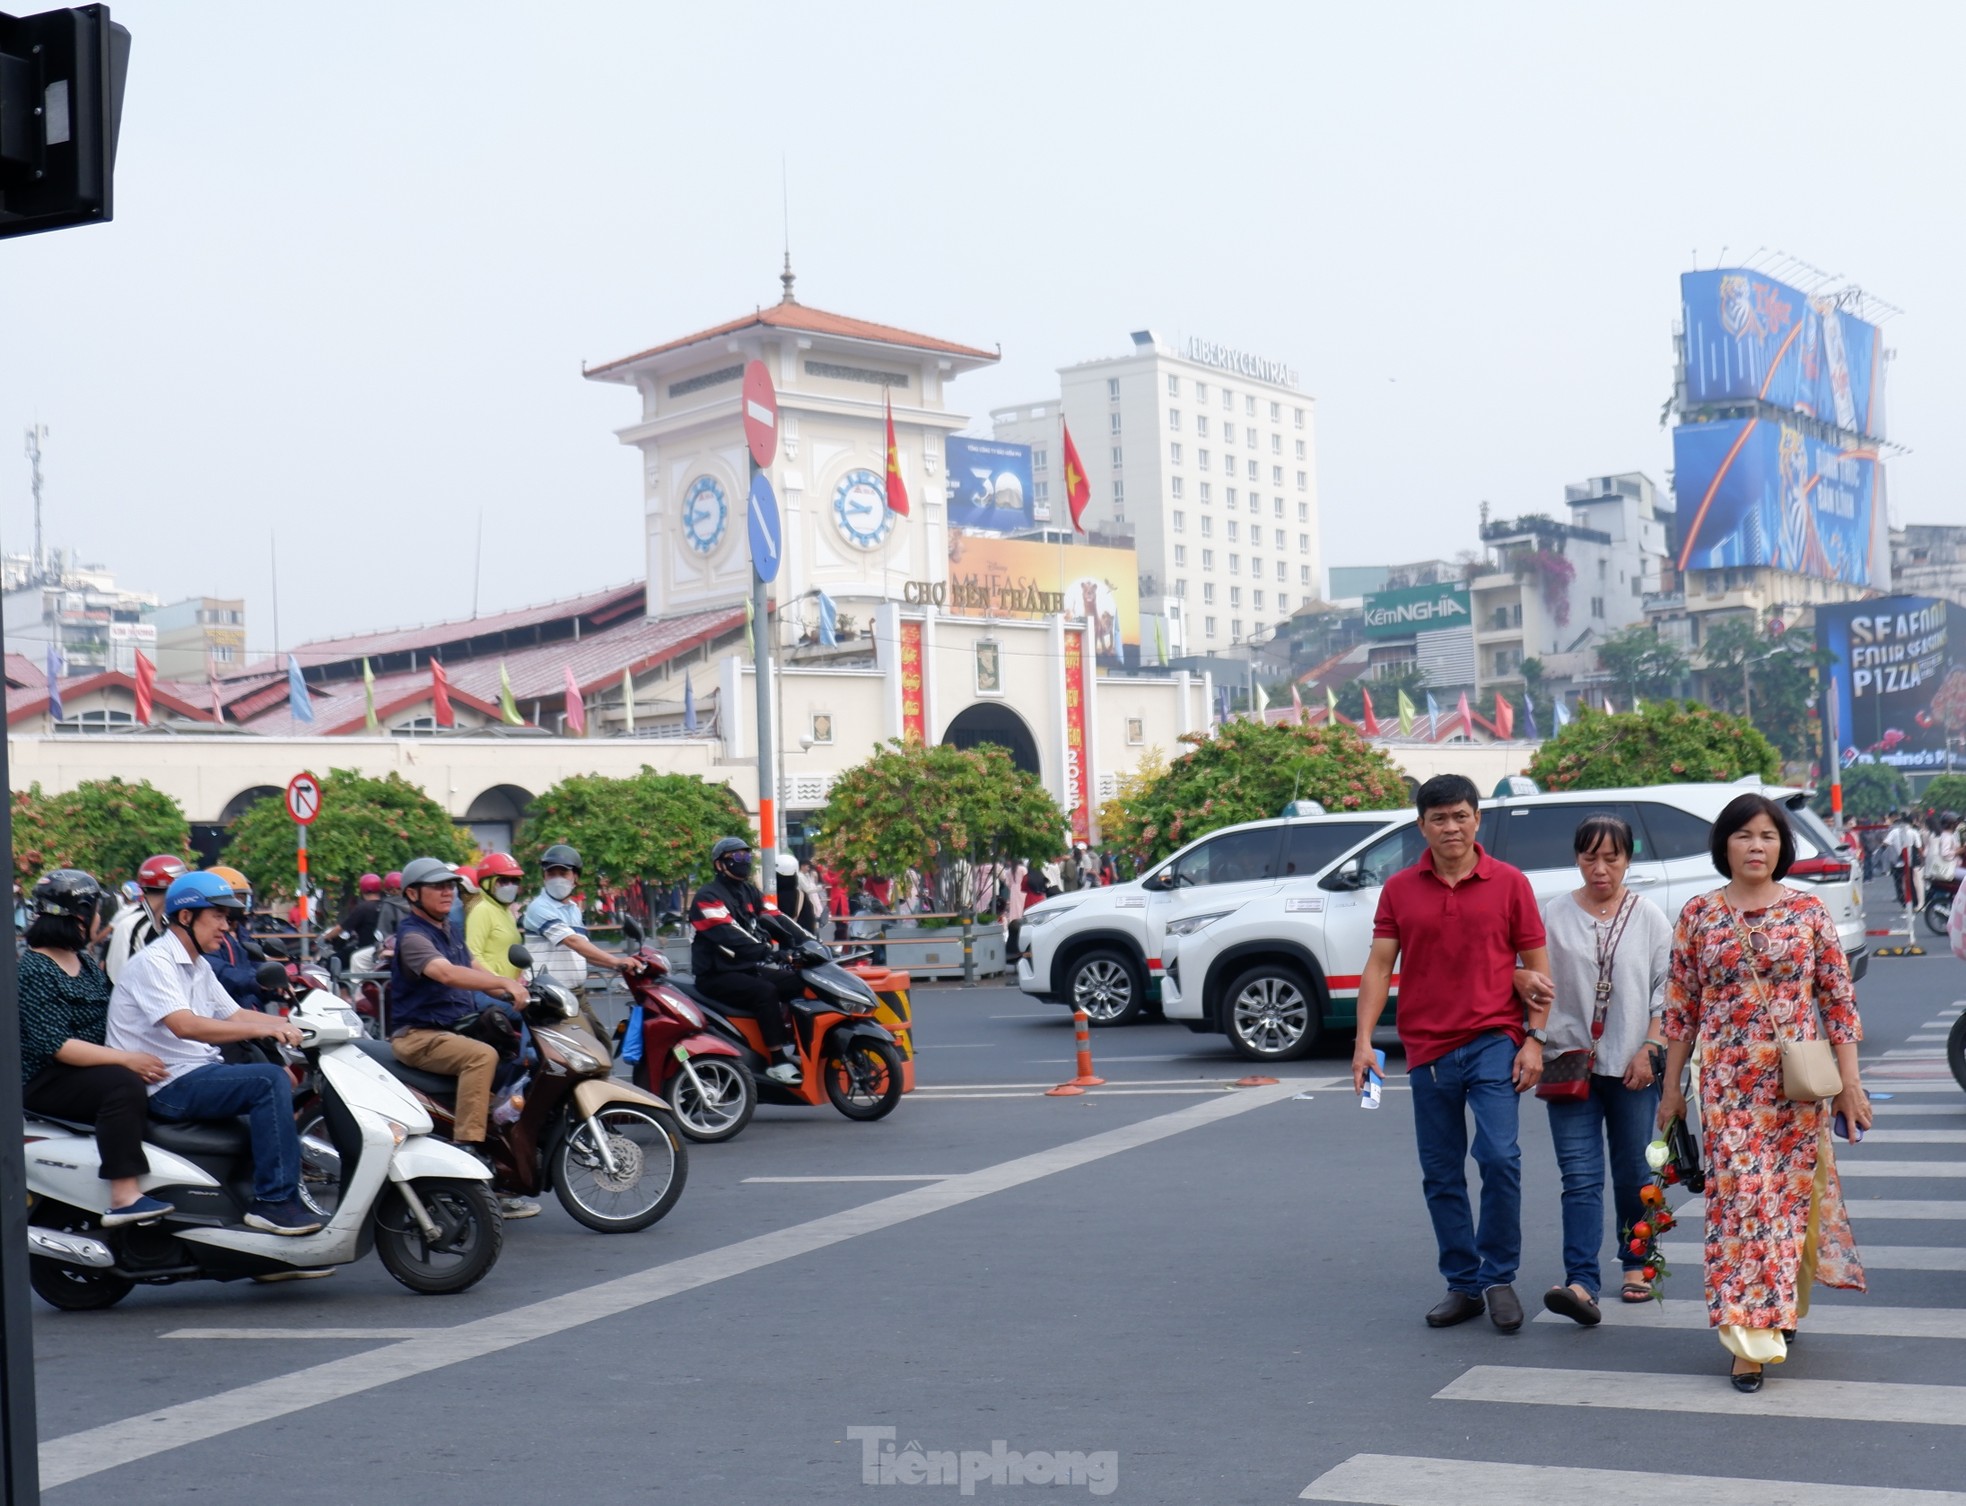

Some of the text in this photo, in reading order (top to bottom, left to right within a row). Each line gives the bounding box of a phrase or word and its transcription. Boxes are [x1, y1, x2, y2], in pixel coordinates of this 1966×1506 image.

[1190, 336, 1239, 371] LIBERTY
[969, 467, 1024, 509] 30
[904, 578, 1065, 613] CHỢ BẾN THÀNH
[1853, 643, 1905, 669] FOUR
[1852, 662, 1922, 697] PIZZA
